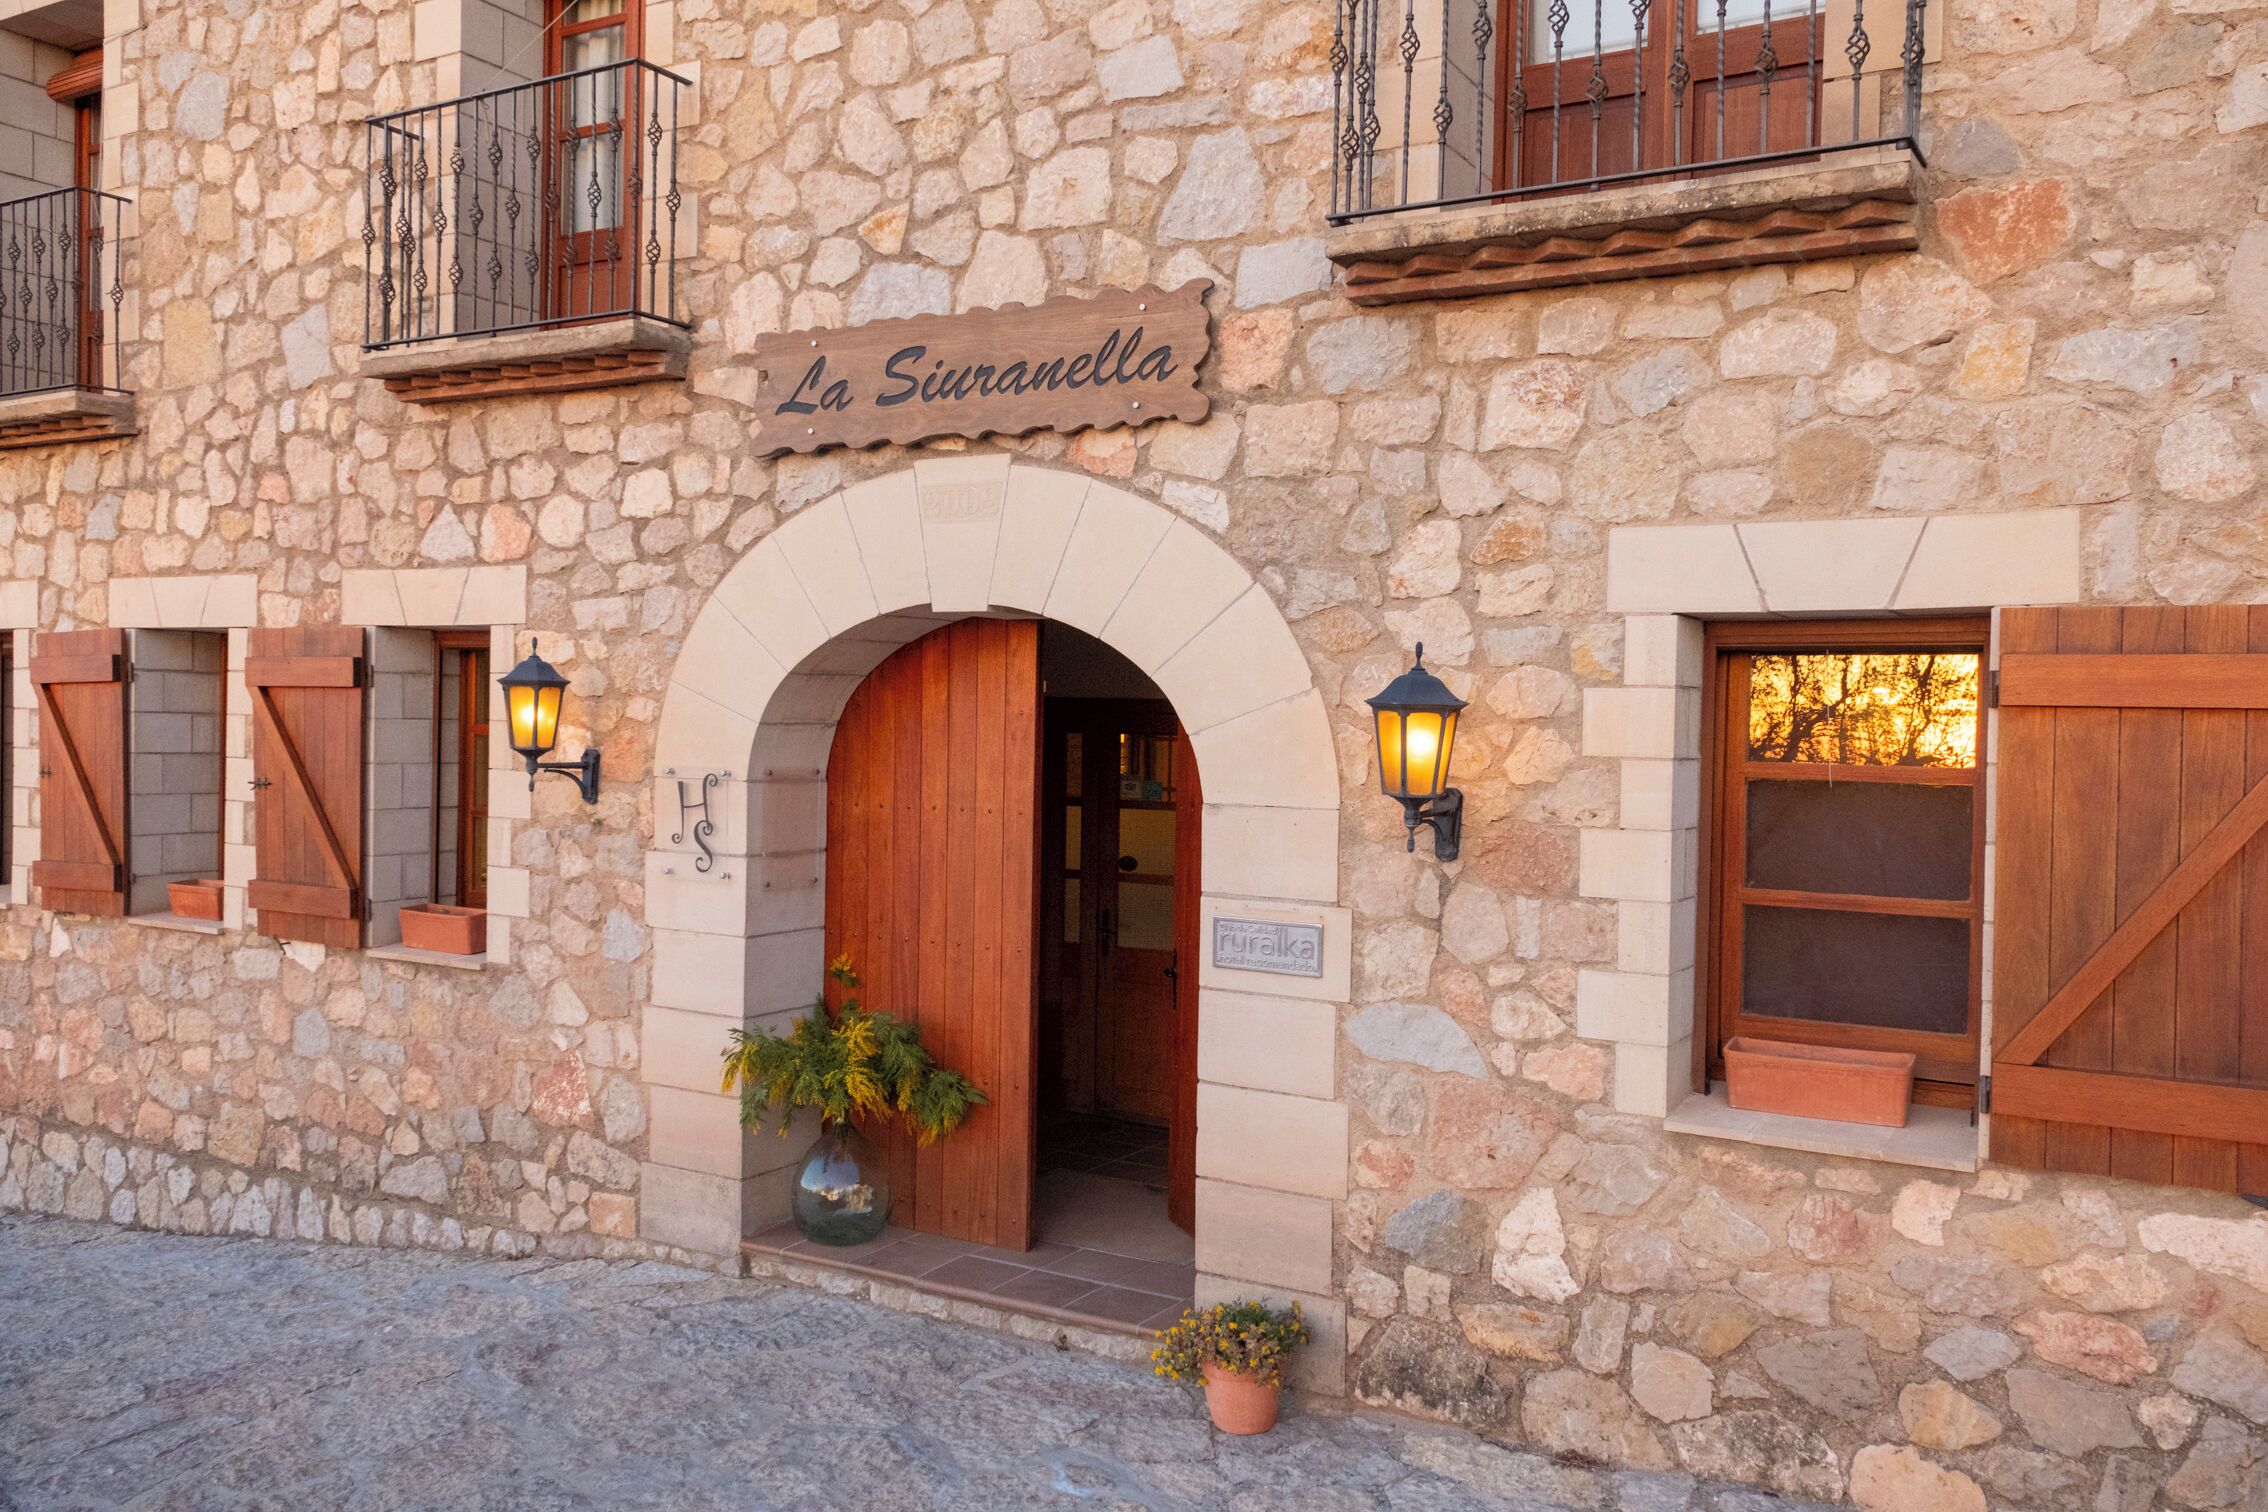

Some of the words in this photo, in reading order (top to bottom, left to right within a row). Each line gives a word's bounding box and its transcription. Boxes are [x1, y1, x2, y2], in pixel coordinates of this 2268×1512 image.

[775, 355, 854, 415] La
[876, 326, 1180, 407] Siuranella
[1219, 927, 1315, 961] ruralka
